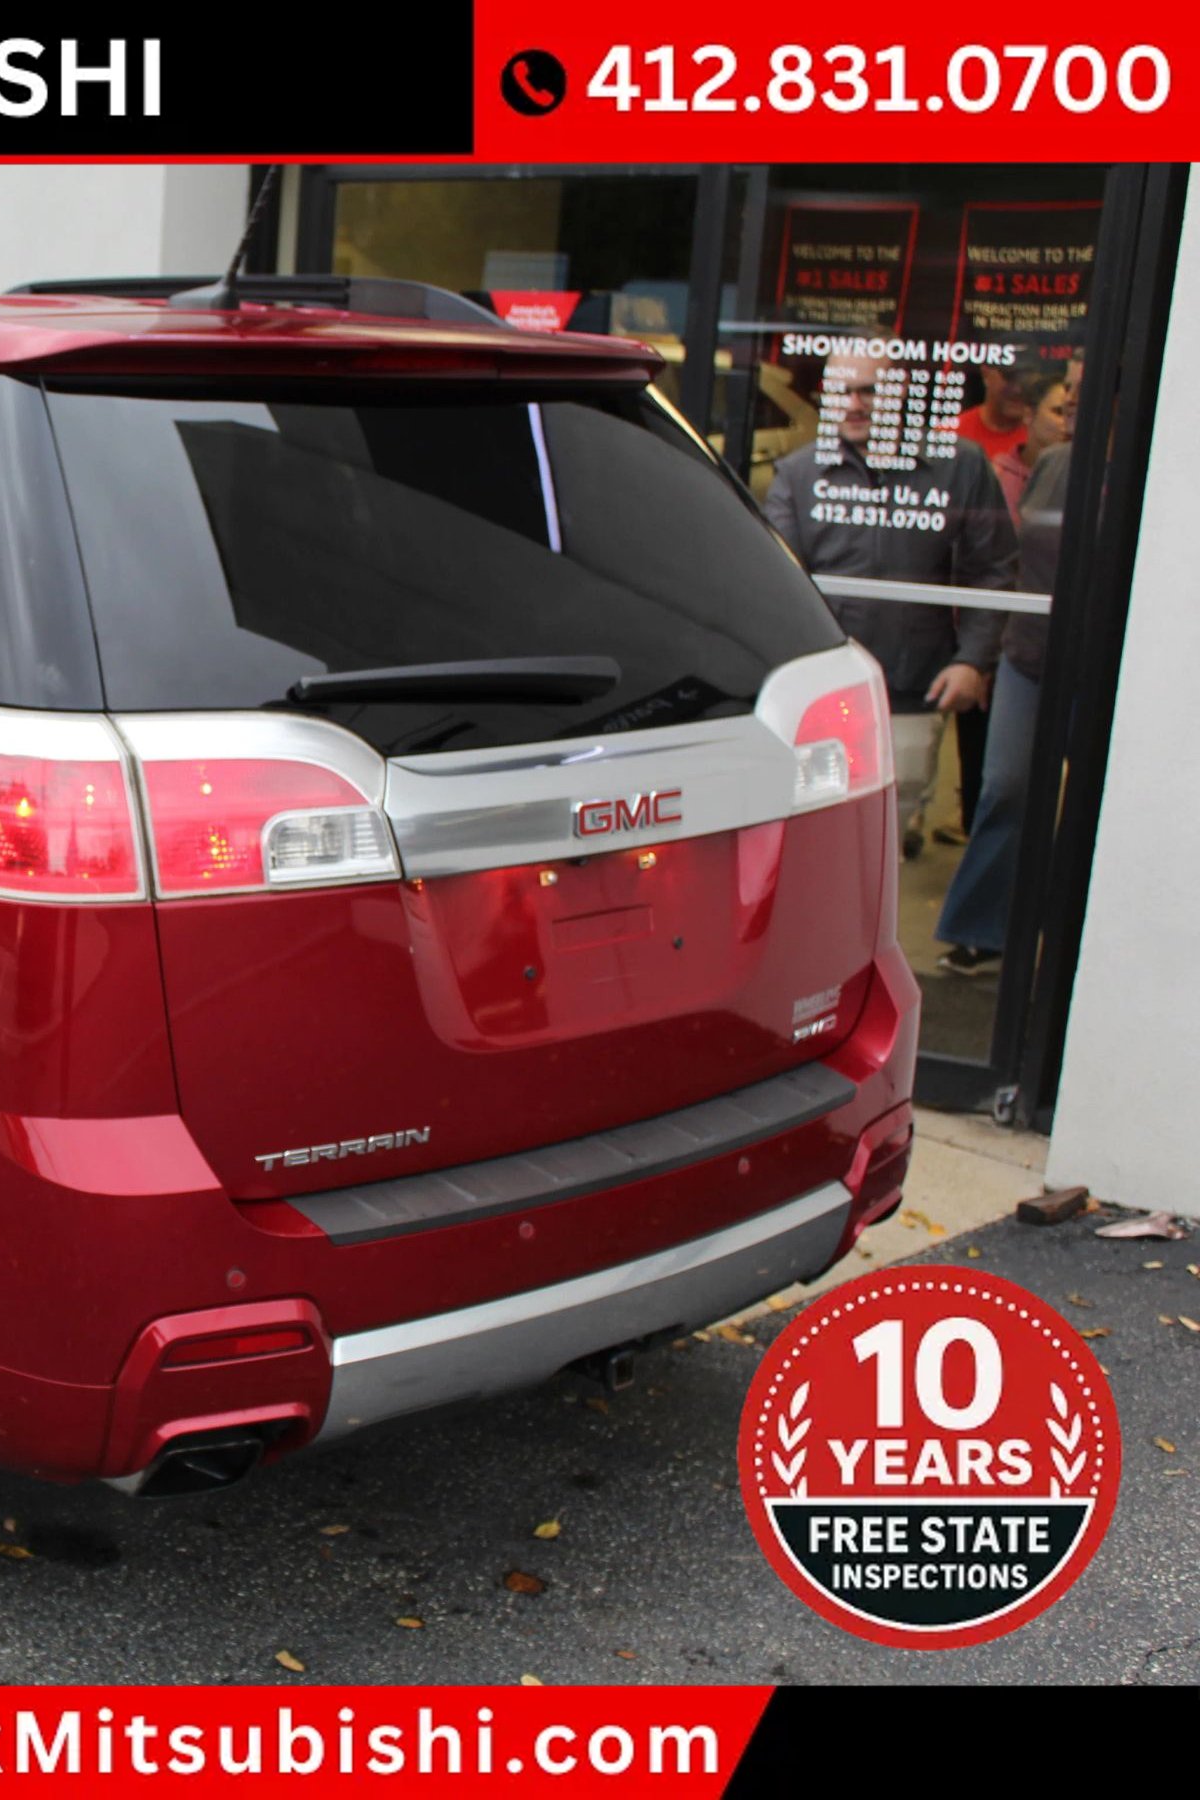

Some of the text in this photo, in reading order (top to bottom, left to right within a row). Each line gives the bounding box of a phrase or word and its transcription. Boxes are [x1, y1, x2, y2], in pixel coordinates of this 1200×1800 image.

[967, 245, 1094, 264] WELCOME TO THE
[829, 270, 889, 292] SALES
[1011, 271, 1080, 295] SALES
[782, 333, 926, 362] SHOWROOM
[933, 340, 1016, 366] HOURS
[911, 369, 930, 383] TO
[908, 384, 928, 398] TO
[907, 398, 926, 412] TO
[906, 413, 925, 427] TO
[904, 428, 923, 442] TO
[900, 442, 919, 456] TO
[813, 478, 950, 508] Contact Us At
[810, 502, 946, 532] 412.831.0700
[573, 788, 682, 839] GMC
[255, 1125, 432, 1172] TERRAIN
